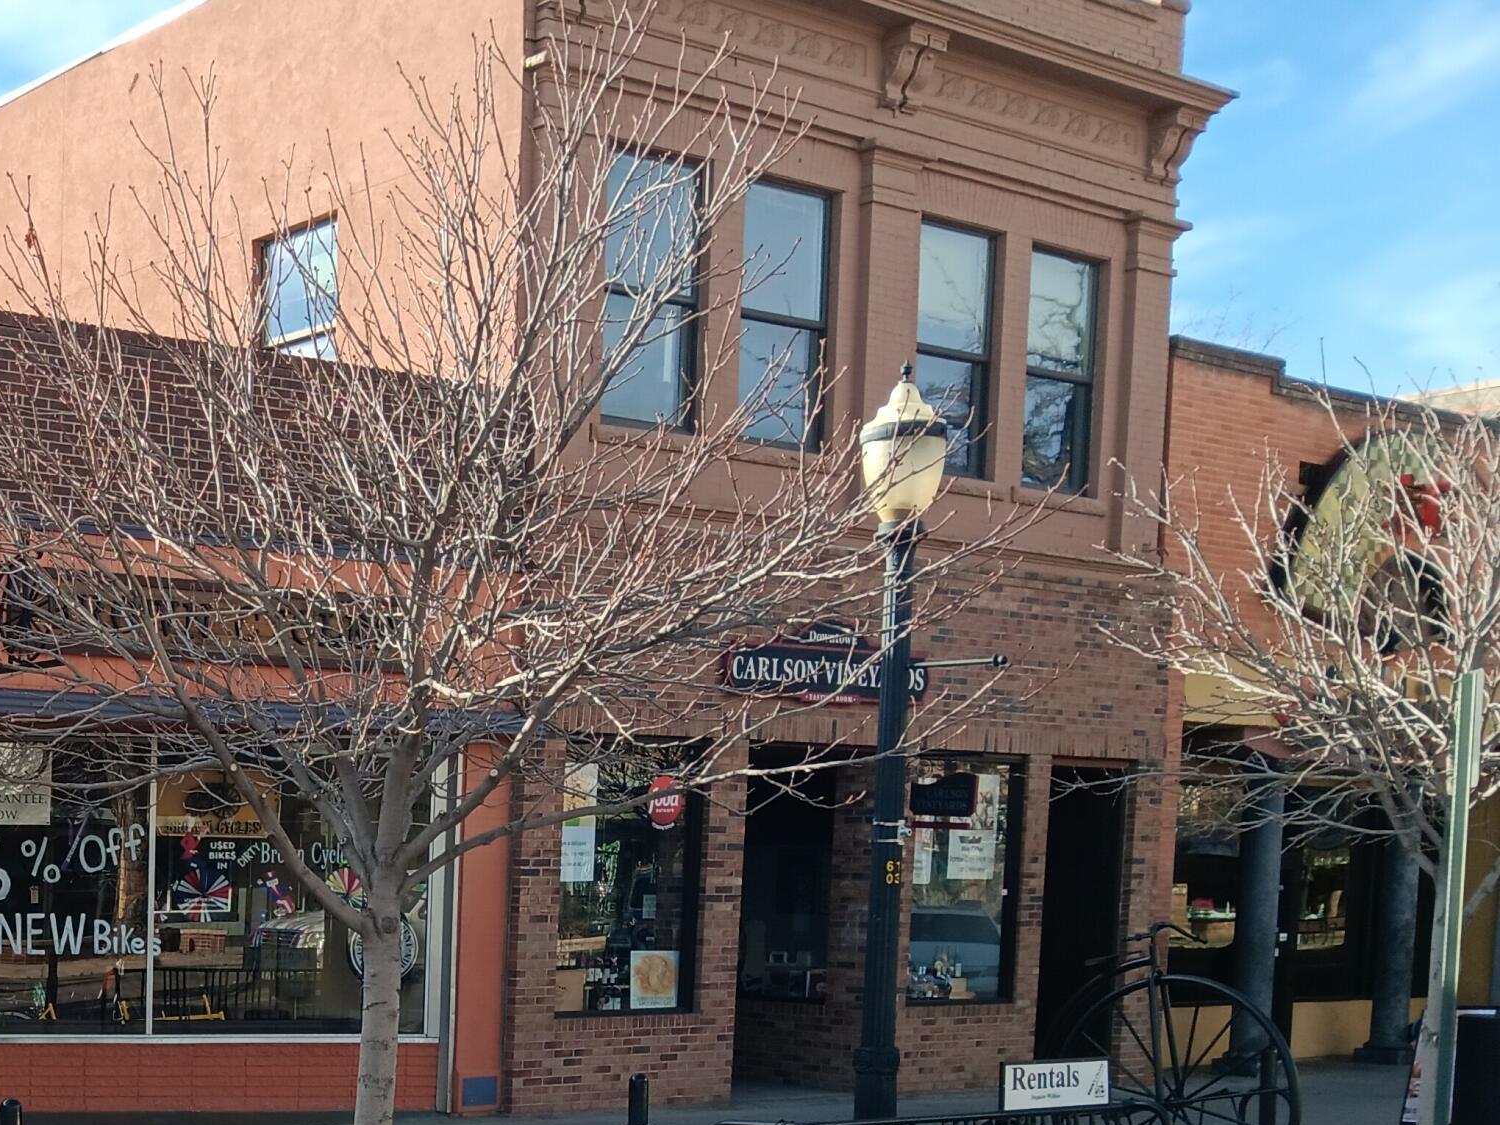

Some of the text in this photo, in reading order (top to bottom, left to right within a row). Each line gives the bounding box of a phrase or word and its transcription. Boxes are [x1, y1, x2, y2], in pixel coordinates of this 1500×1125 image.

[732, 655, 925, 692] CARLSON VINEYS
[216, 862, 227, 870] IN
[237, 841, 349, 870] DIRTY Bron Cycle
[1011, 1064, 1080, 1091] Rentals
